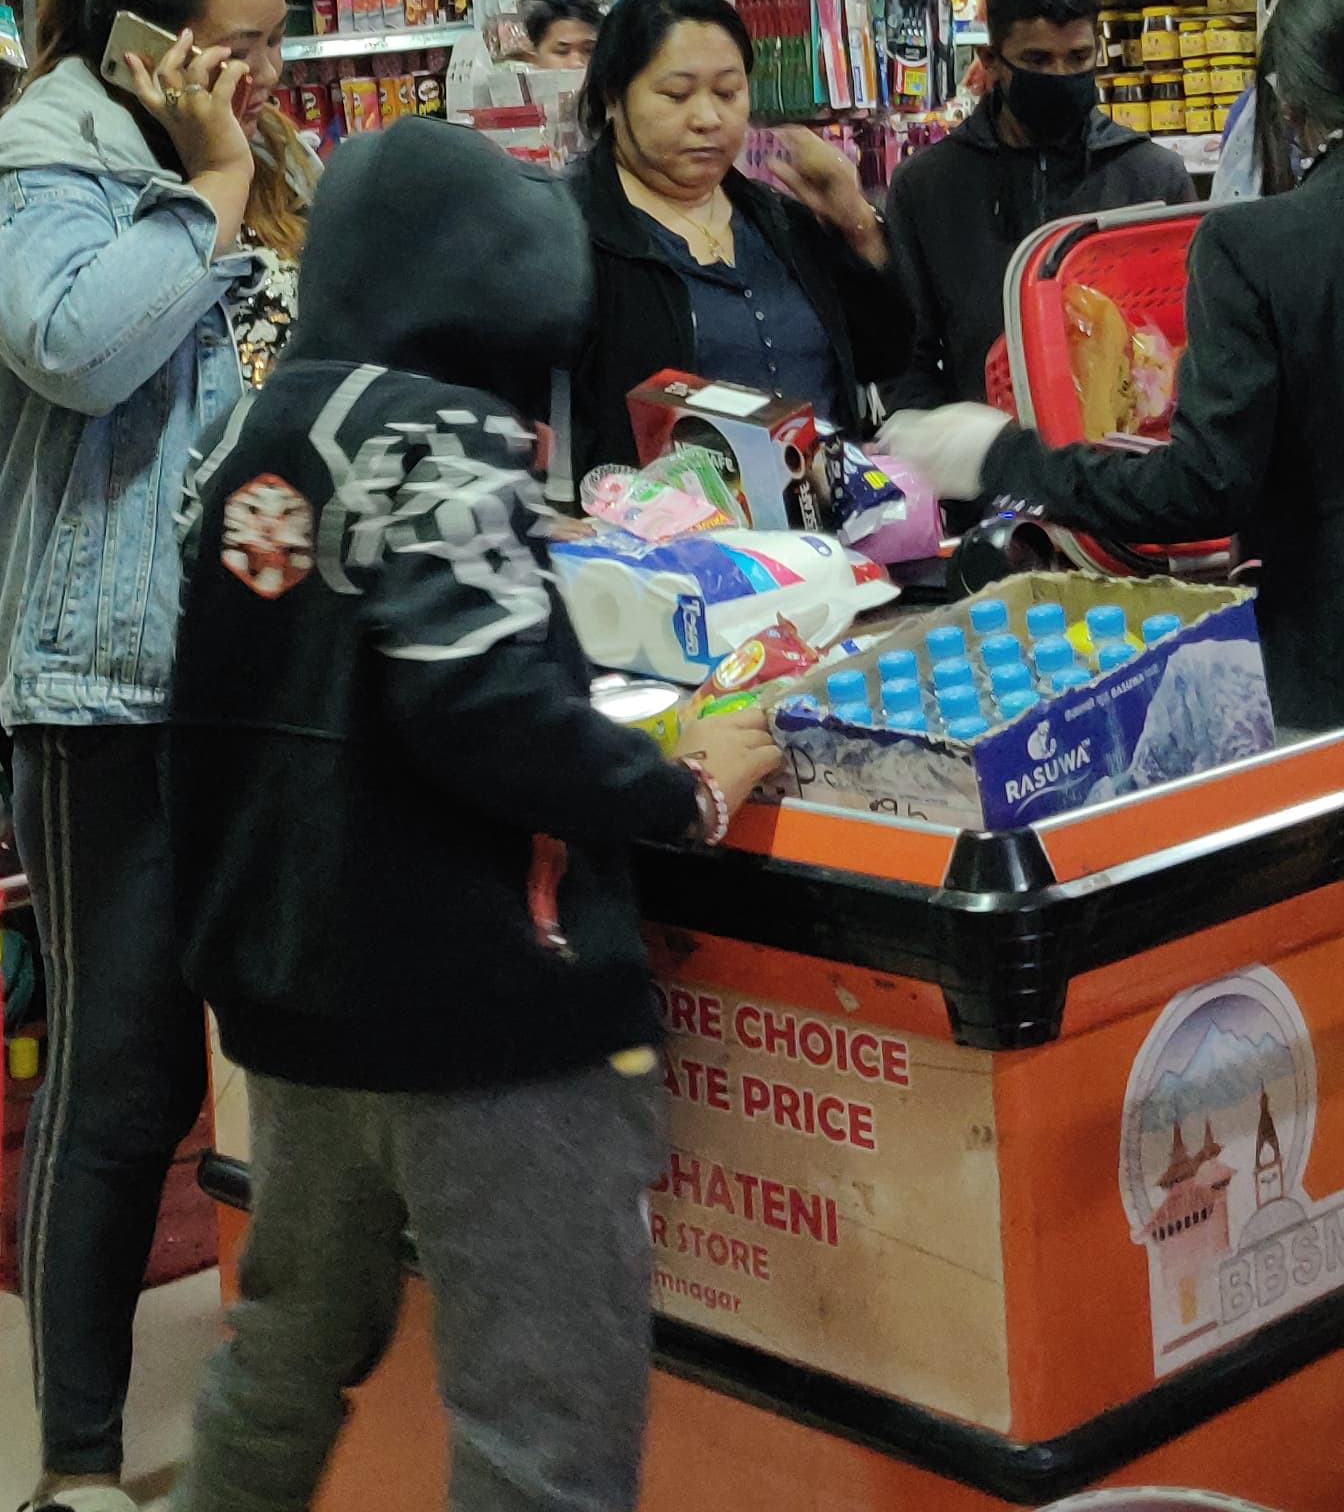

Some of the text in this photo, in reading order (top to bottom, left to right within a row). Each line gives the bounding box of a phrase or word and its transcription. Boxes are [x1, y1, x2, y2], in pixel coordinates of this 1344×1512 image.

[1006, 745, 1091, 805] RASUWA
[735, 1006, 909, 1087] CHOICE
[742, 1076, 876, 1150] PRICE
[677, 1221, 770, 1281] STORE
